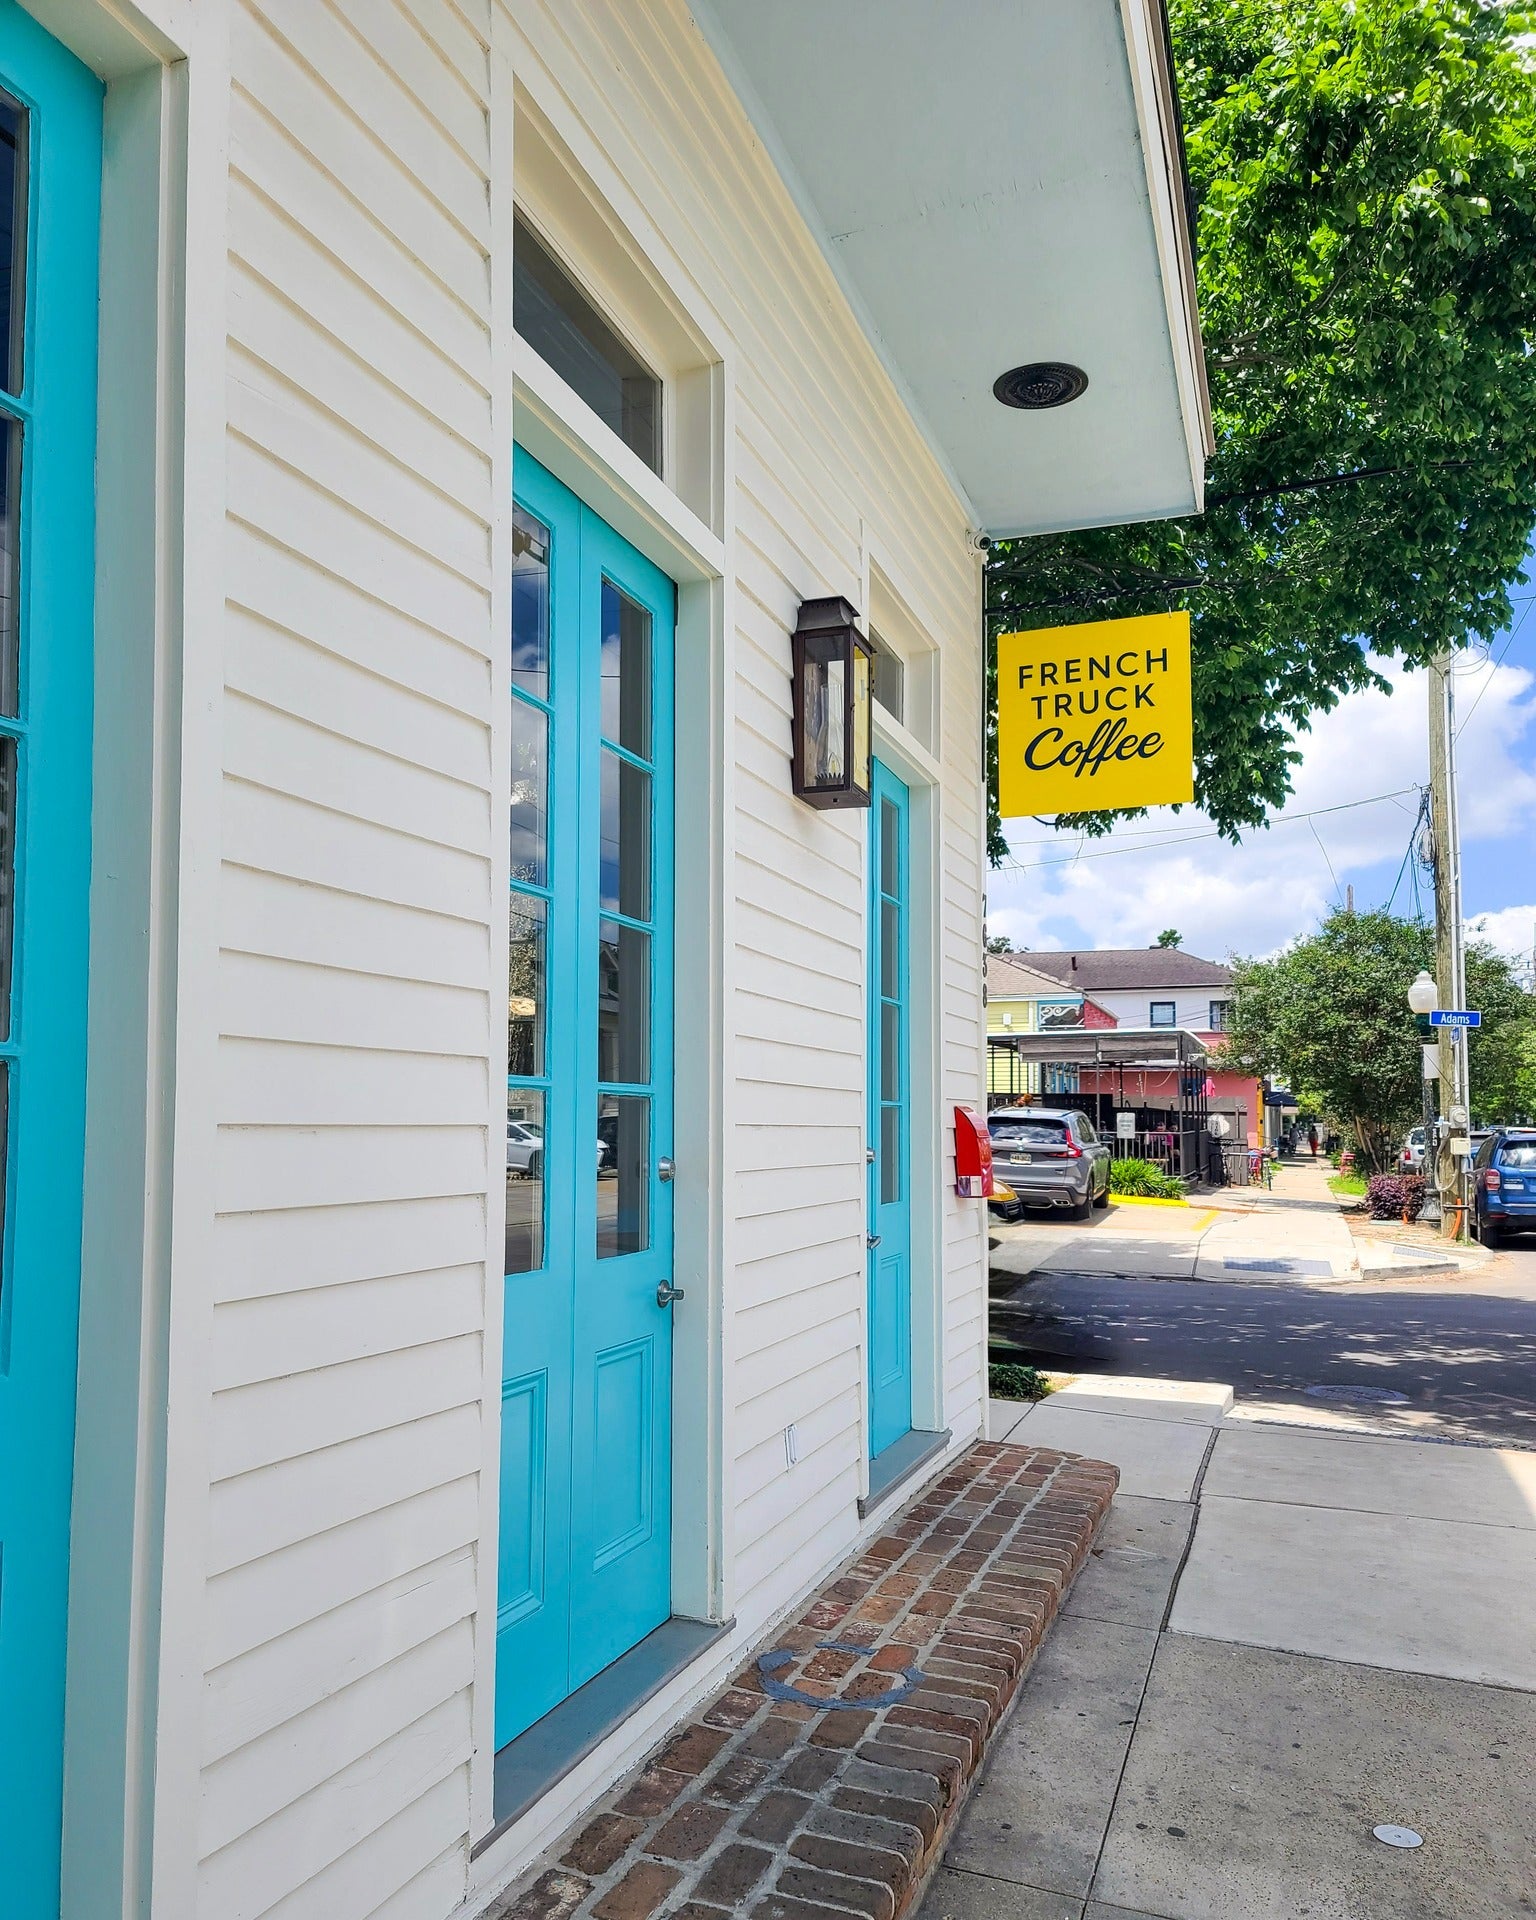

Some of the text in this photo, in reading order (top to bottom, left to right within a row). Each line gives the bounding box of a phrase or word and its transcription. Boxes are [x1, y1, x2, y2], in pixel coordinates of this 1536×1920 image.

[1018, 647, 1168, 690] FRENCH
[1031, 682, 1156, 720] TRUCK
[1024, 717, 1165, 779] Coffee
[1440, 1013, 1471, 1025] Adams
